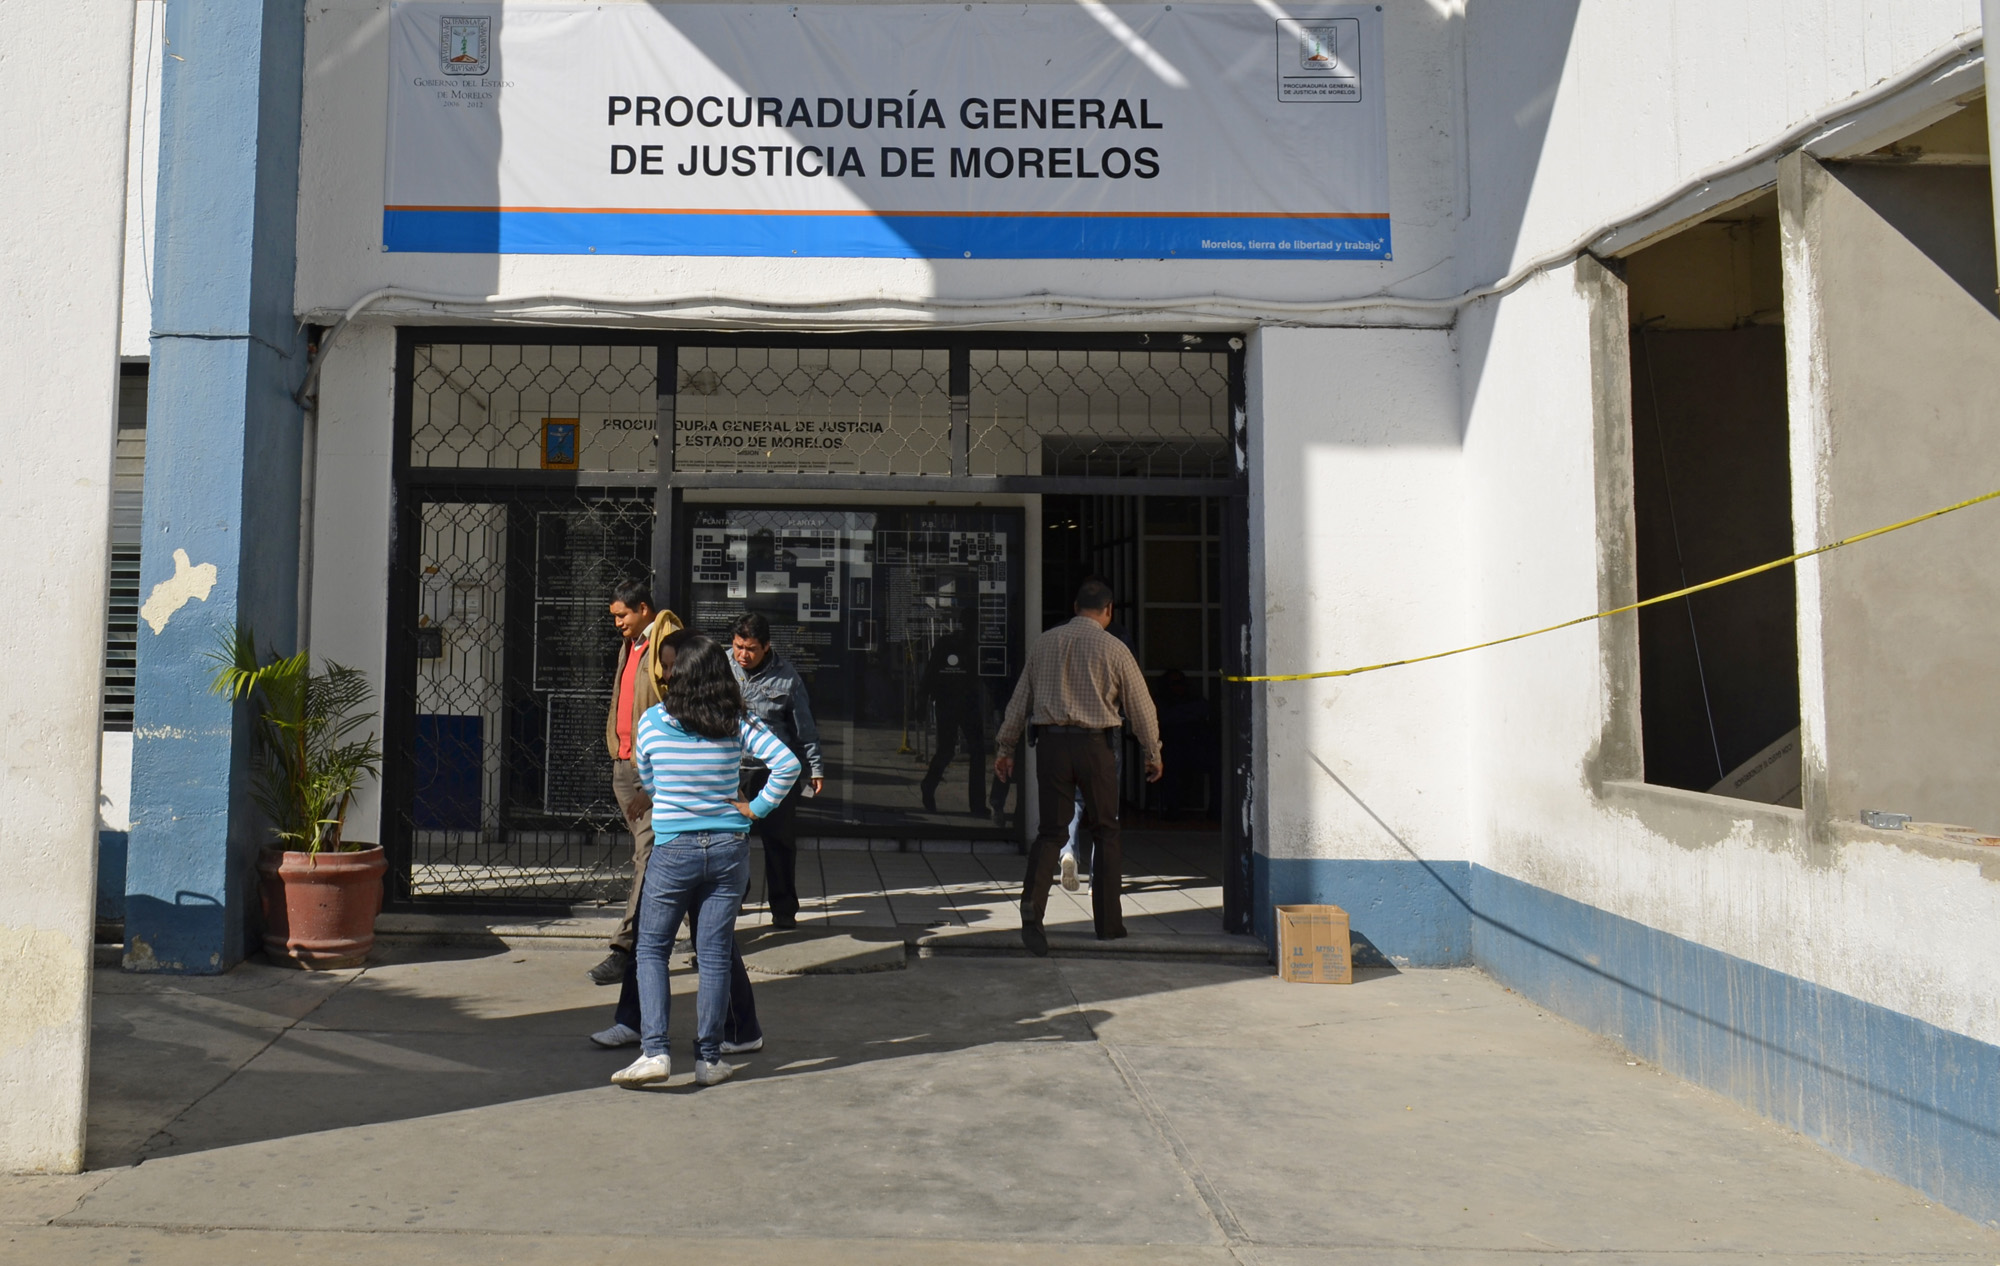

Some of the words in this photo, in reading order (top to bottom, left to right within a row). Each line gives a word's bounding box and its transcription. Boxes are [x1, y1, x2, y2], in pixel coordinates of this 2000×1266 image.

[451, 90, 493, 99] MORELOS
[608, 89, 945, 129] PROCURADURÍA
[960, 98, 1163, 129] GENERAL
[611, 145, 664, 175] DE
[678, 145, 865, 178] JUSTICIA
[881, 147, 935, 178] DE
[950, 147, 1160, 179] MORELOS
[1201, 240, 1246, 250] Morelos,
[1248, 240, 1275, 249] tierra
[1278, 240, 1291, 249] de
[1294, 240, 1333, 249] libertad
[1335, 243, 1342, 251] y
[1344, 240, 1381, 251] trabajo
[722, 420, 791, 432] GENERAL
[795, 421, 815, 432] DE
[819, 421, 884, 433] JUSTICIA
[685, 436, 744, 447] ESTADO
[748, 437, 767, 447] DE
[771, 437, 843, 449] MORELOS
